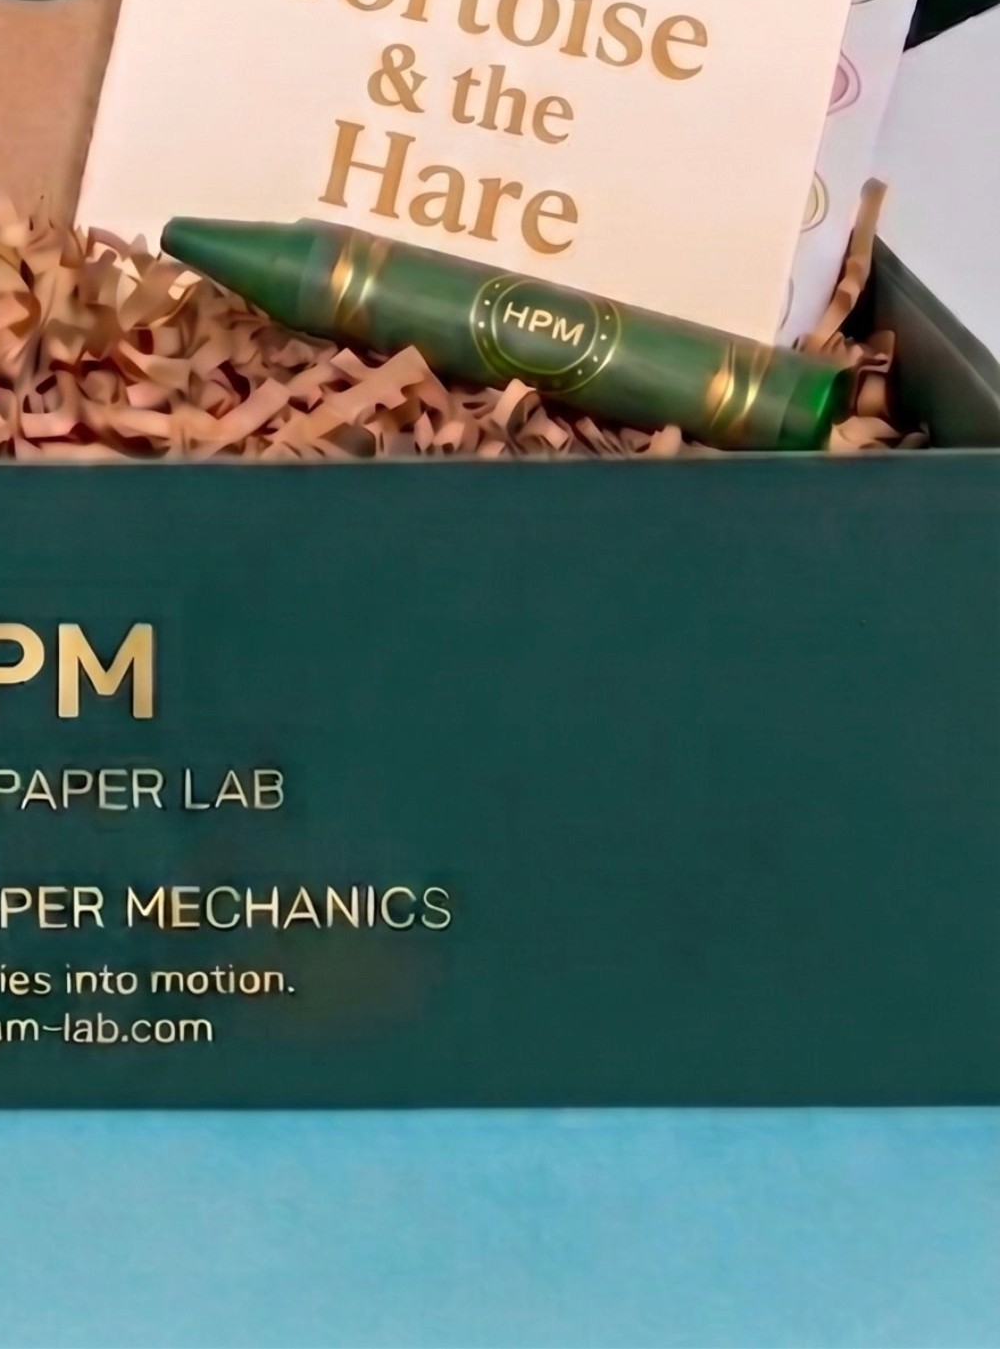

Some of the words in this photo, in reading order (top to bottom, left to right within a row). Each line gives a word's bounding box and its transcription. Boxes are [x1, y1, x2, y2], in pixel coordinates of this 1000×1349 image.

[366, 43, 428, 114] &
[451, 65, 575, 145] the
[317, 119, 580, 258] Hare
[503, 301, 585, 346] HPM
[184, 768, 285, 811] LAB
[126, 884, 452, 930] MECHANICS
[65, 963, 139, 996] into
[150, 963, 296, 995] motion.
